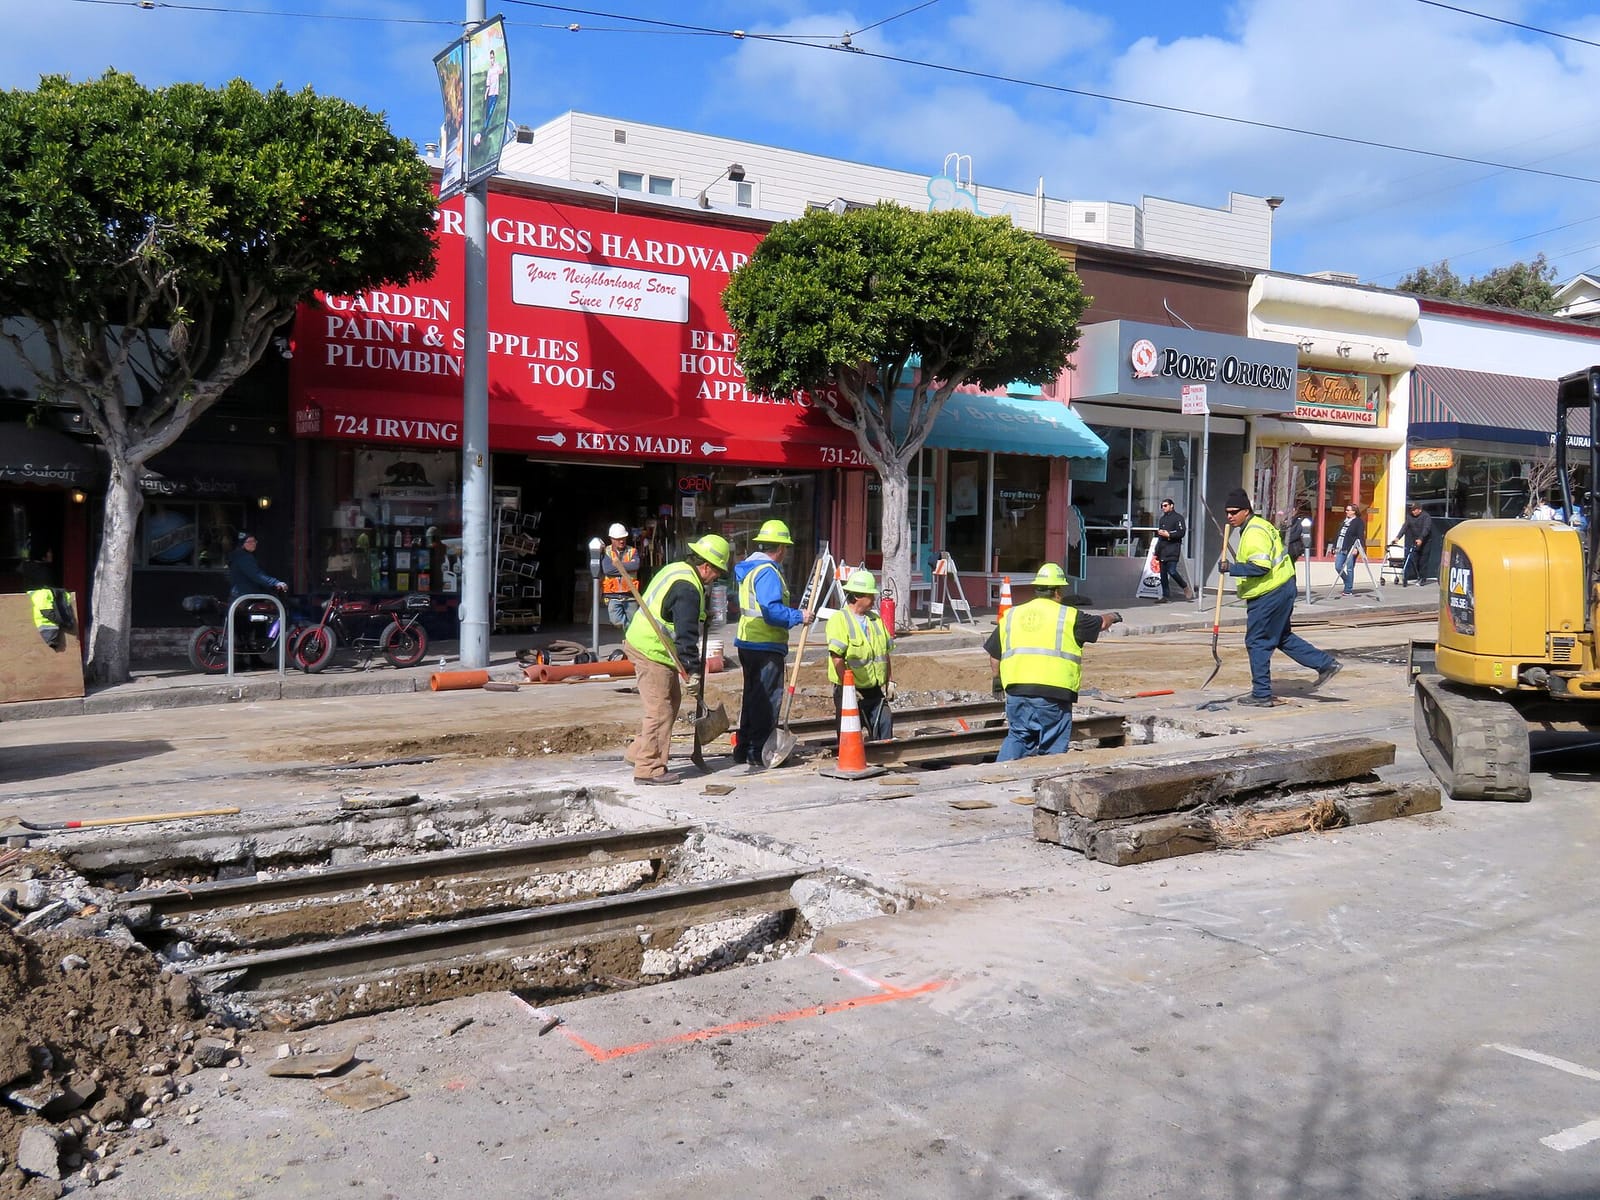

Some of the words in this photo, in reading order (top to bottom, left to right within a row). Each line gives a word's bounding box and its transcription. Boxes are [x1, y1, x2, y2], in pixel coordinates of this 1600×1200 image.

[434, 209, 593, 254] RGRESS
[600, 233, 750, 273] HARDWAR
[526, 263, 558, 283] Your
[563, 266, 642, 291] Neighborhood
[646, 278, 677, 296] Store
[326, 291, 451, 322] GARDEN
[569, 290, 602, 308] Since
[608, 295, 642, 312] 1948
[326, 316, 415, 344] PAINT
[423, 324, 445, 348] &
[452, 328, 579, 363] SPPLIES
[326, 343, 464, 377] PLUMBIN
[1162, 348, 1217, 382] POKE
[1222, 354, 1294, 390] ORIGIN
[528, 363, 616, 392] TOOLS
[334, 415, 369, 435] 724
[375, 418, 458, 442] IRVING
[1296, 407, 1328, 418] EXICAN
[1330, 409, 1372, 422] CRAVINGS
[576, 432, 630, 453] KEYS
[635, 436, 692, 455] MADE
[820, 446, 873, 466] 731-20
[678, 478, 712, 492] OPEN
[867, 484, 881, 494] asy
[1450, 567, 1470, 595] CAT
